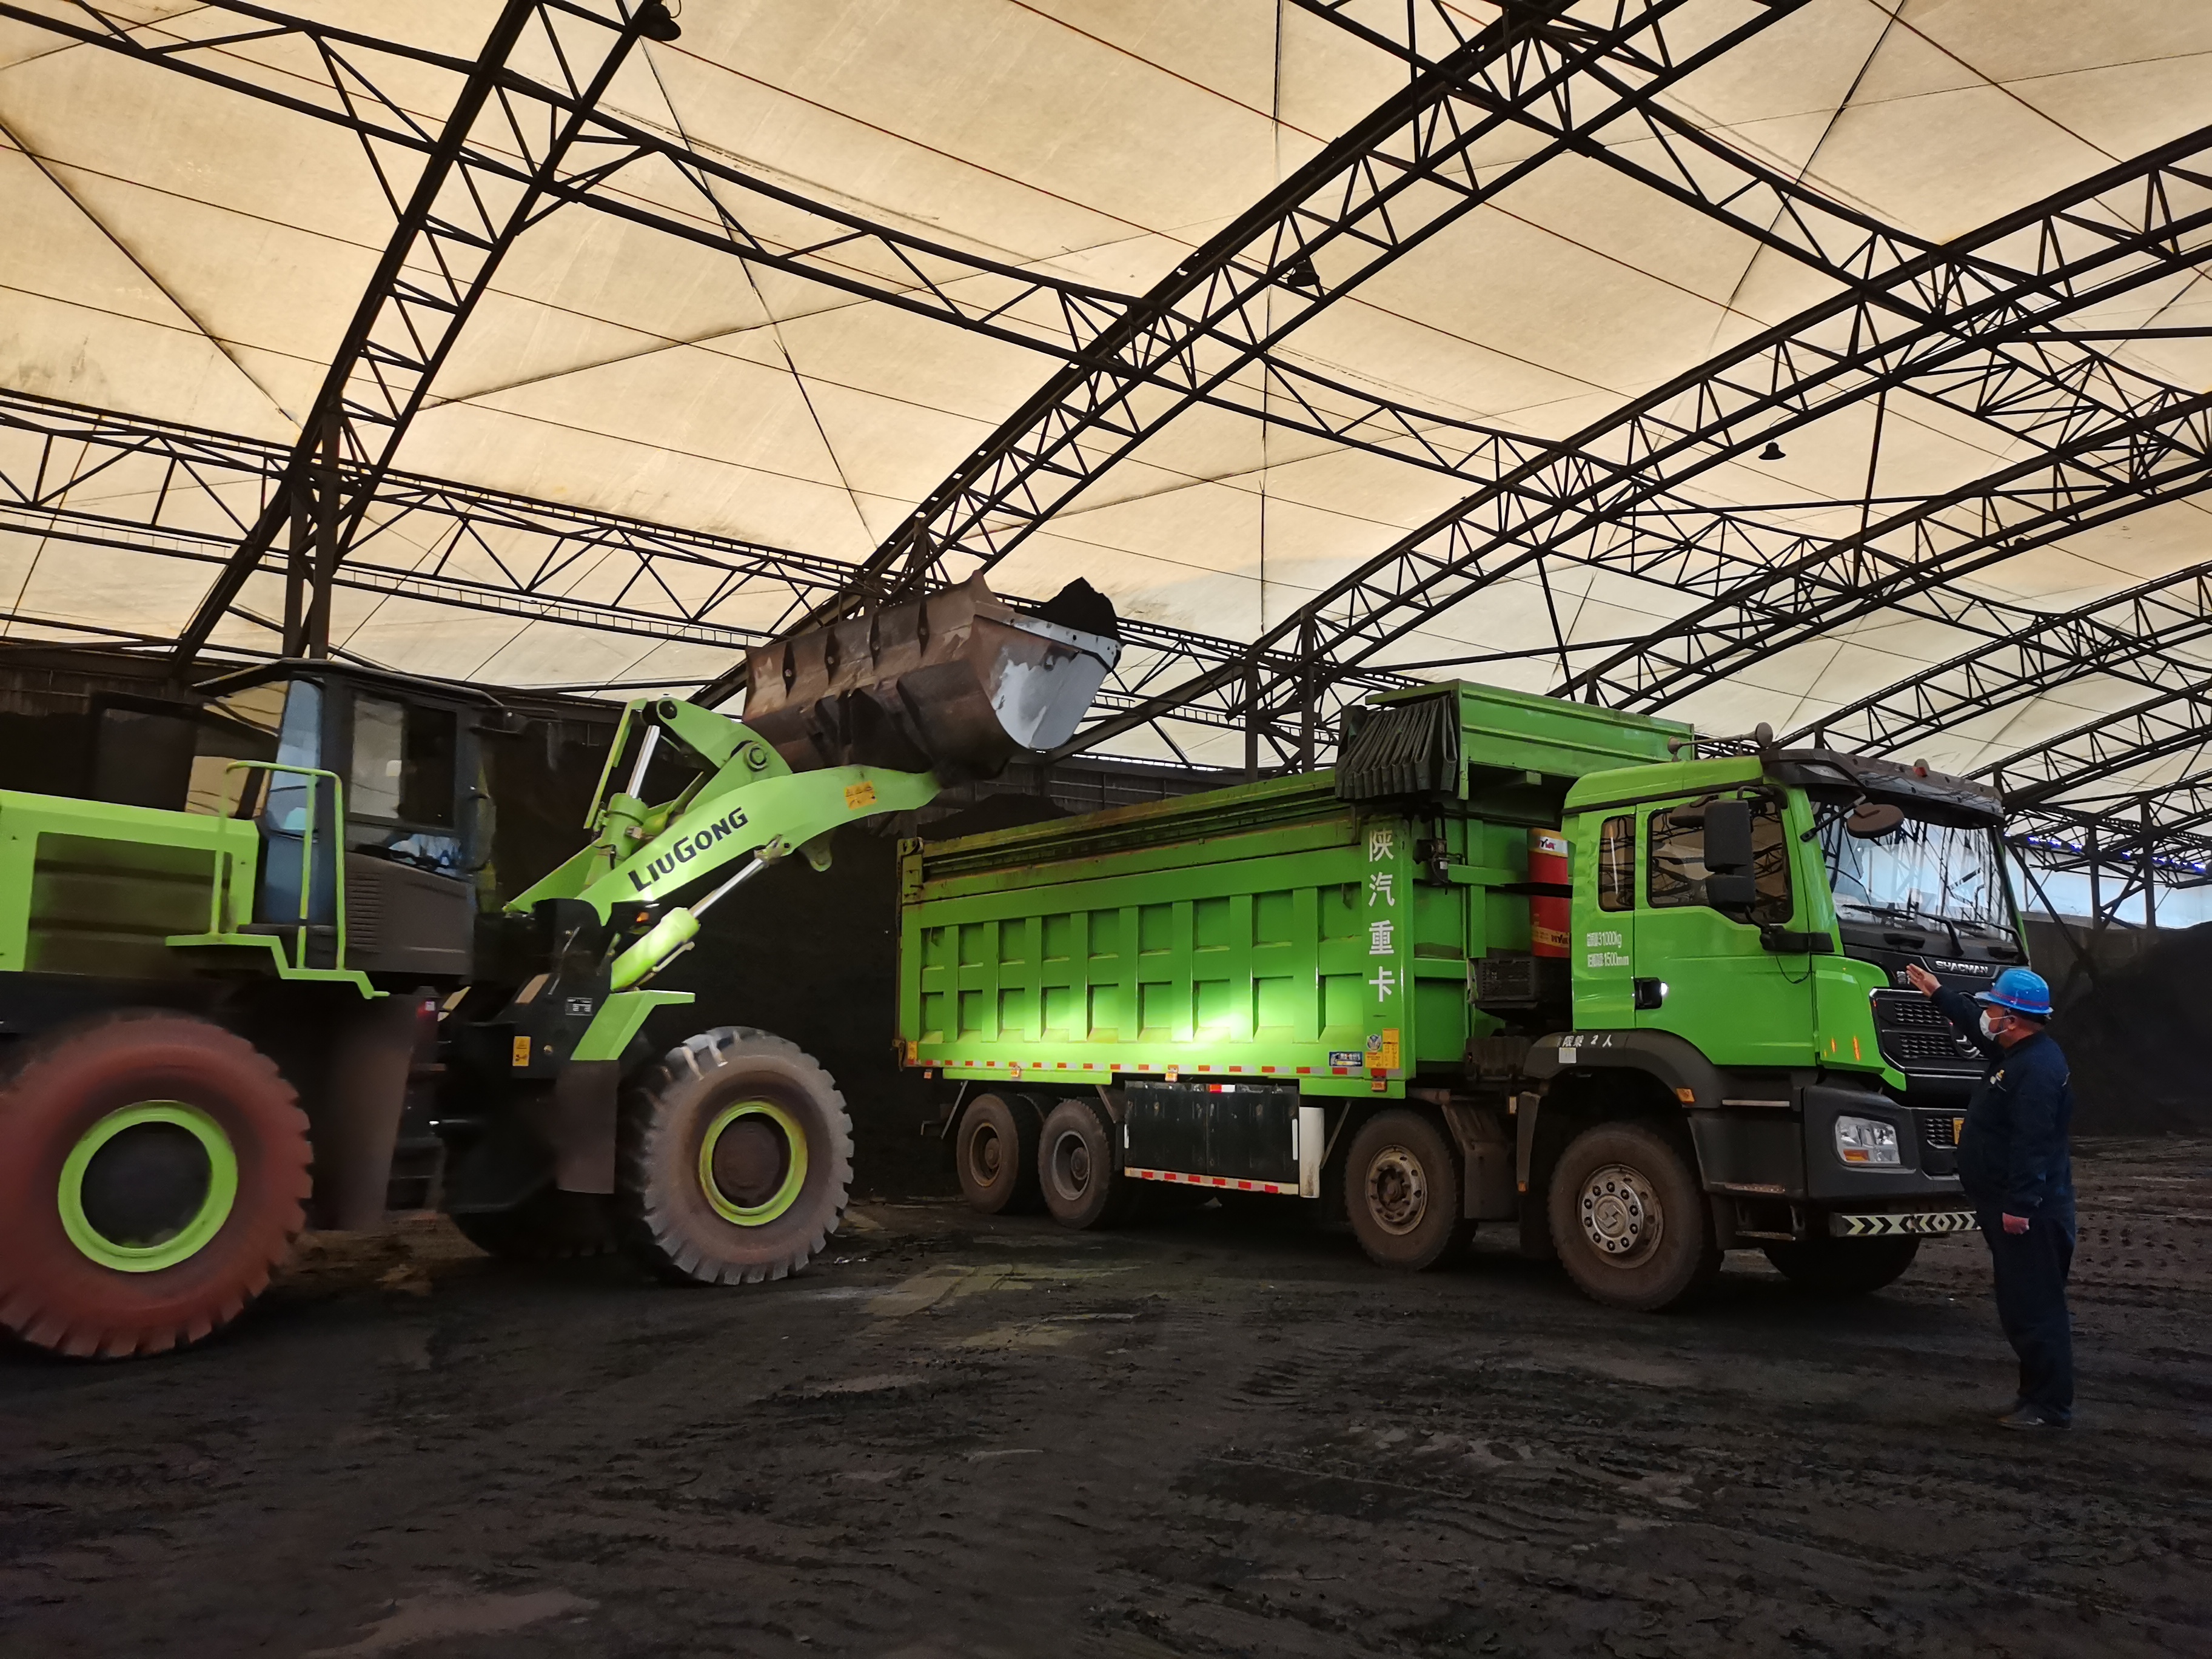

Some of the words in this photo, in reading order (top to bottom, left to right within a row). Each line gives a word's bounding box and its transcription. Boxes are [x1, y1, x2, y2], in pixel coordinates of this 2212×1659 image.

[628, 806, 749, 892] LIUGONG
[1369, 829, 1395, 1002] 陕汽重卡
[1935, 960, 1988, 974] SHACMAN
